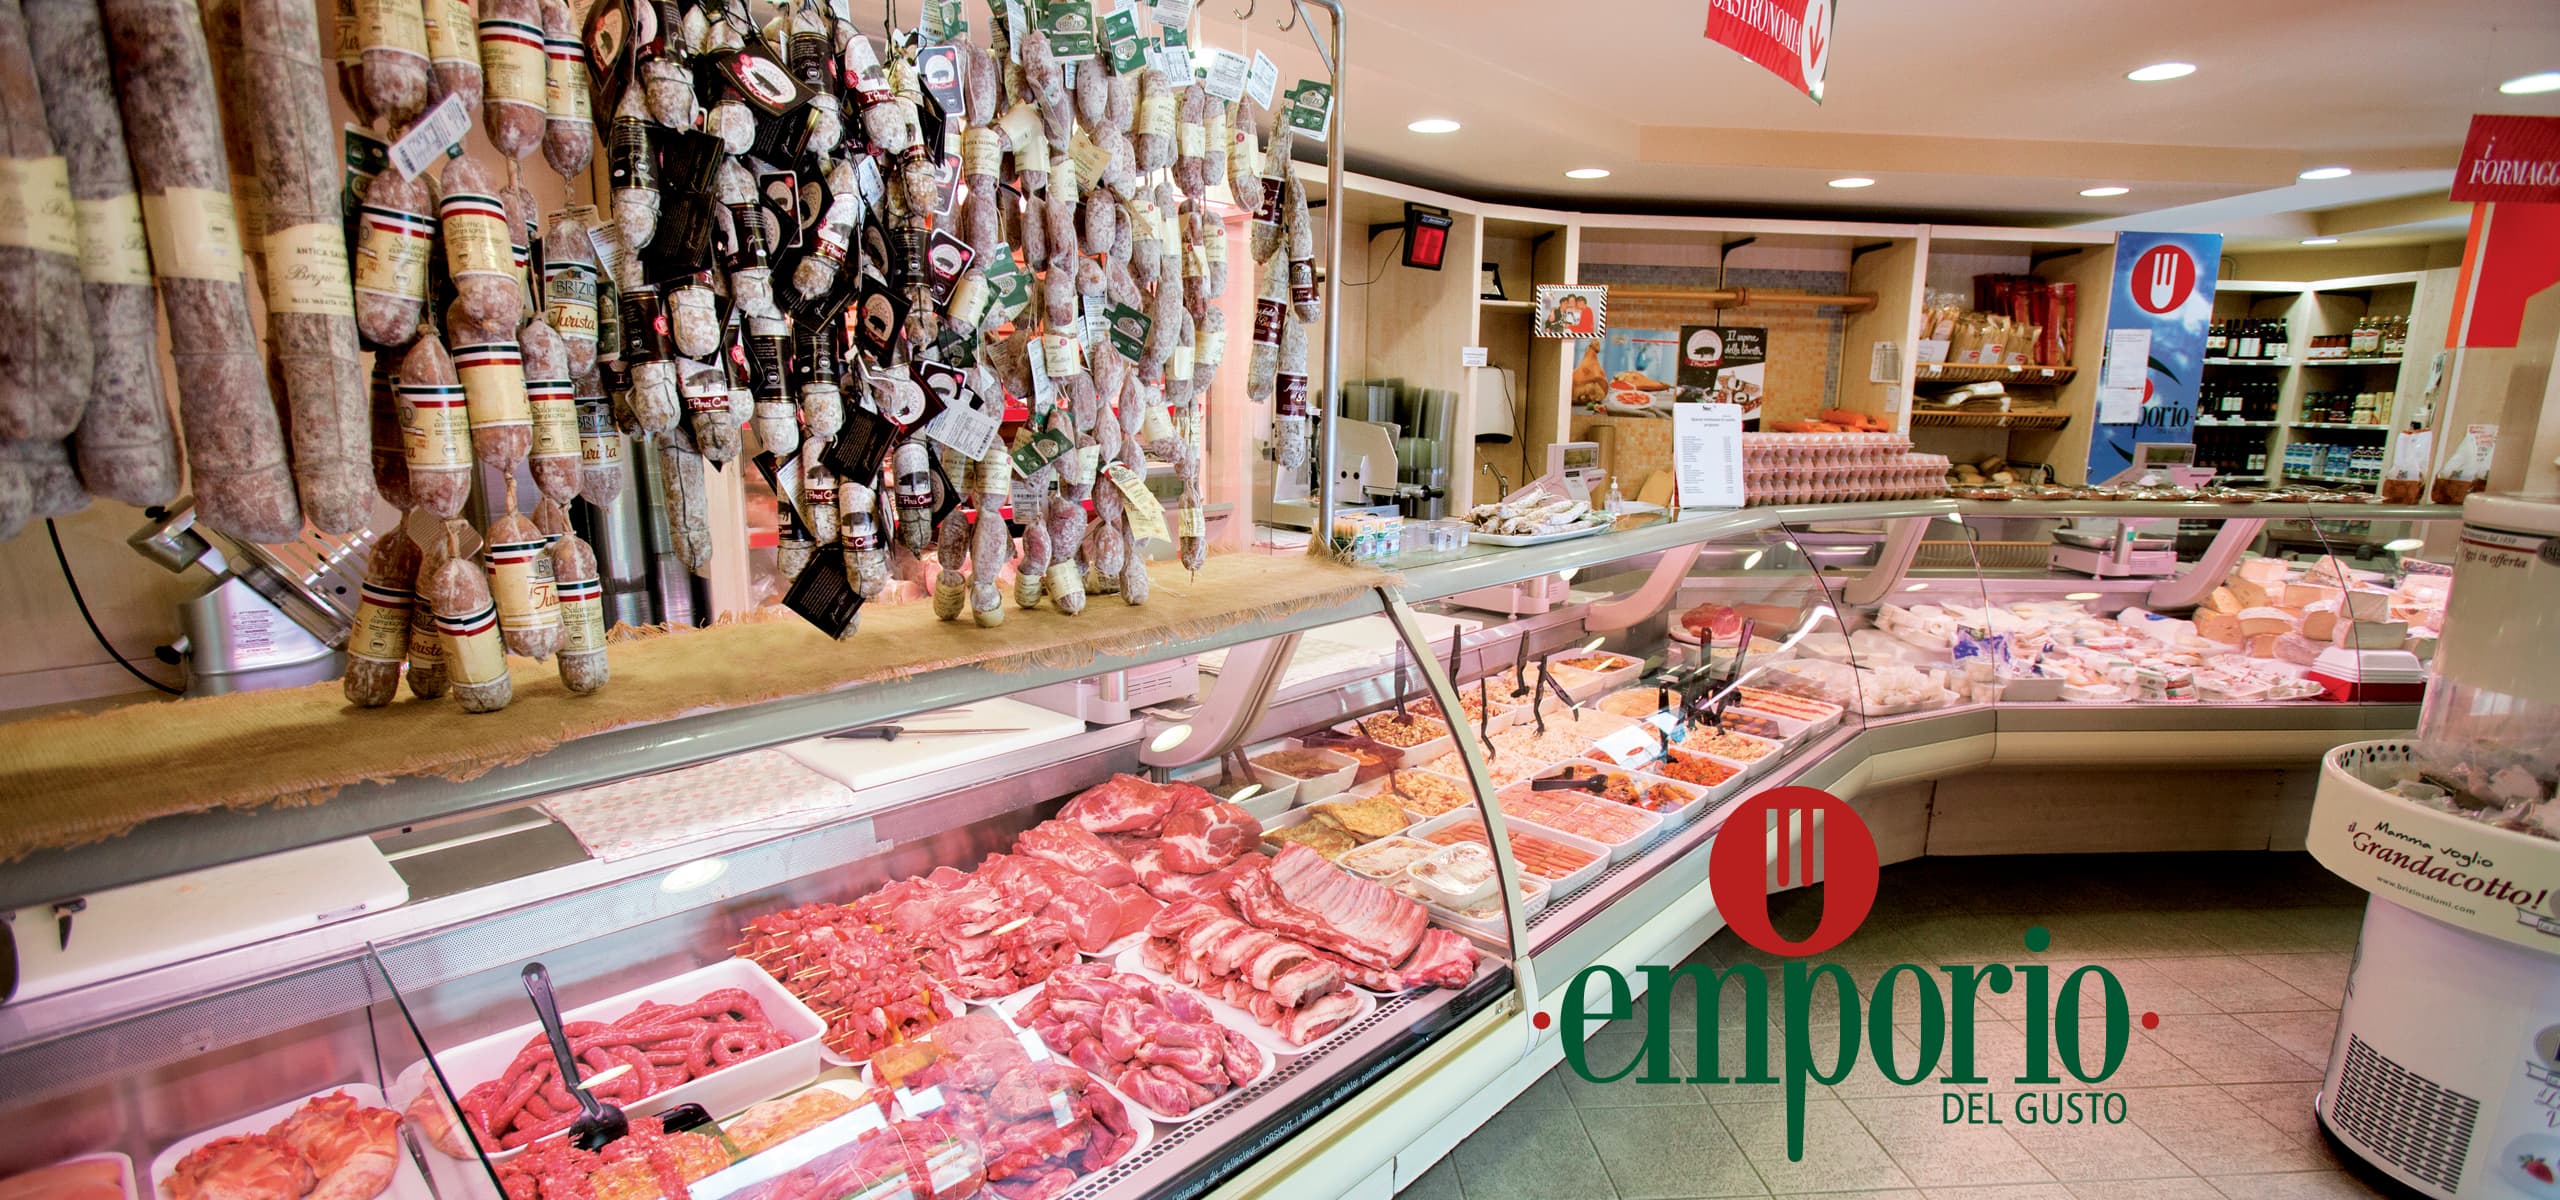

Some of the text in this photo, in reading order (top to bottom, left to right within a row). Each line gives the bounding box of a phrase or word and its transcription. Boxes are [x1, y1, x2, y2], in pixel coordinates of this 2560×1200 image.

[1712, 0, 1803, 57] STRONOMIA
[2485, 136, 2496, 159] i
[2114, 400, 2189, 439] porio
[2489, 553, 2528, 569] offerta
[2374, 821, 2494, 868] Mamma voglio
[2353, 831, 2549, 910] Grandacotto!
[2376, 875, 2477, 916] www.briziosalumi.com
[1259, 1119, 1294, 1148] VORSICHT
